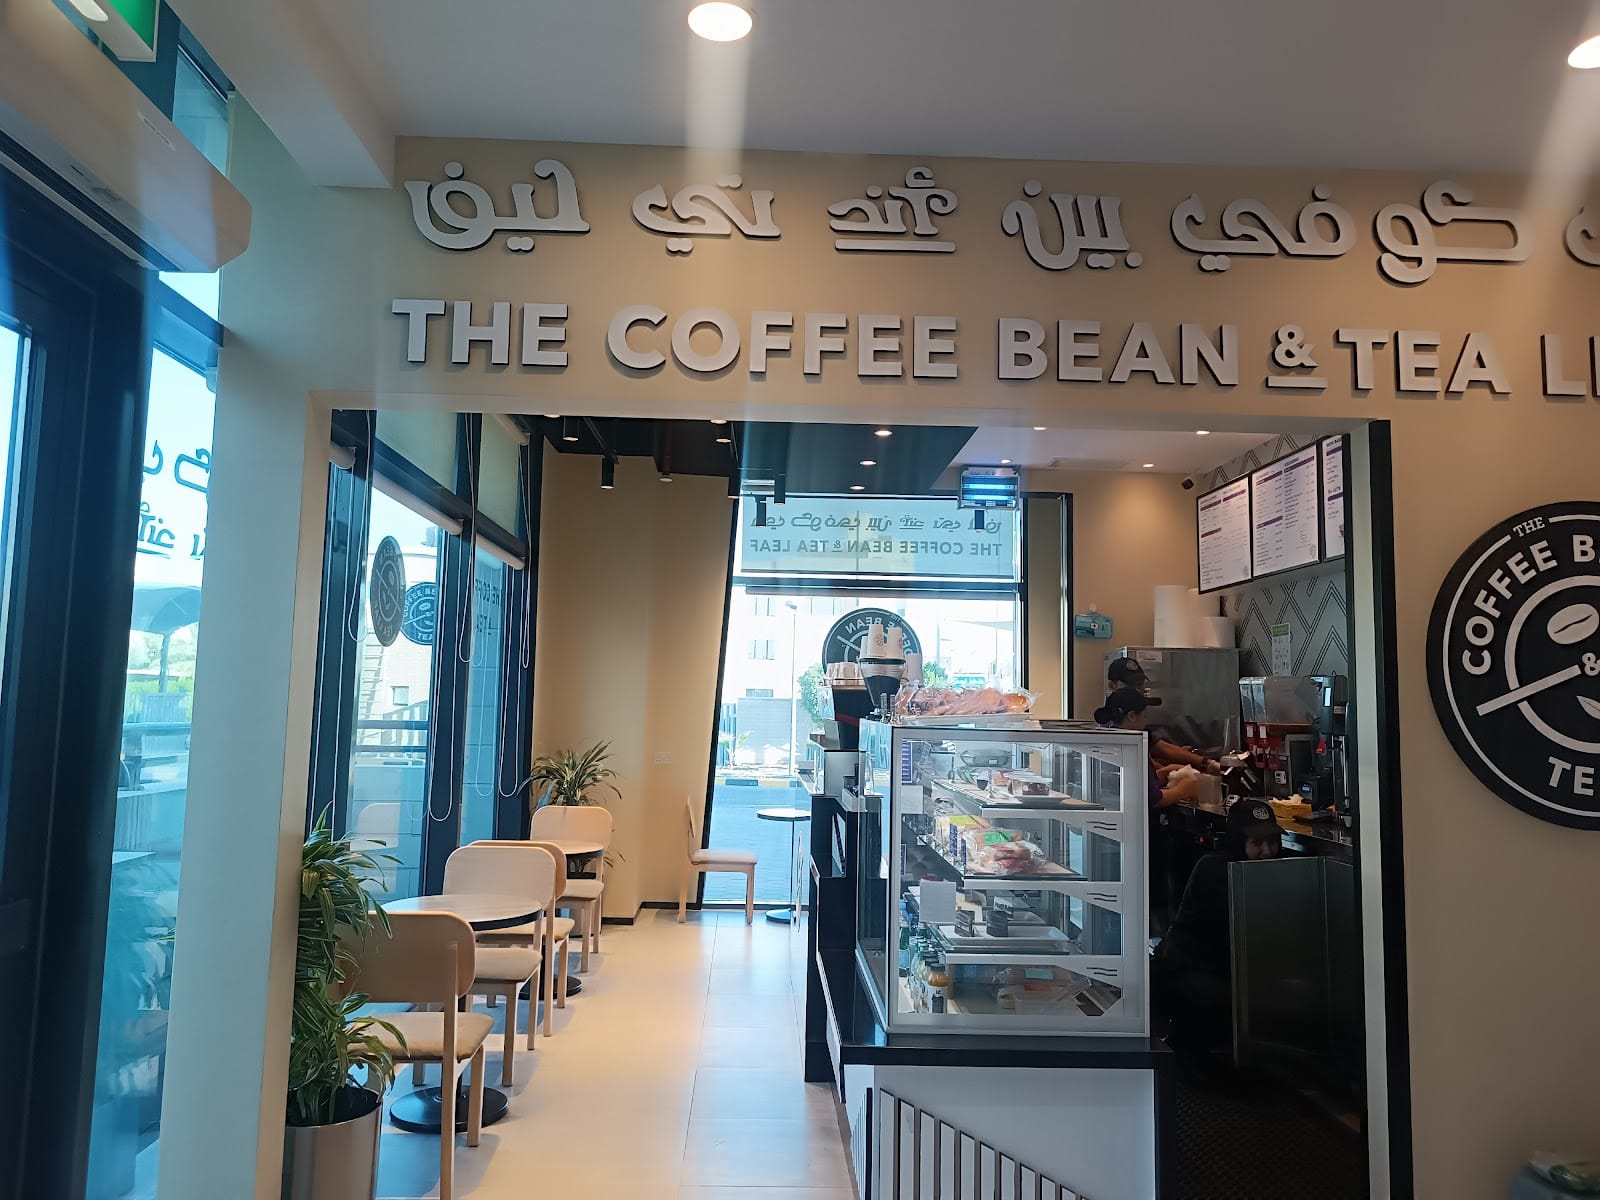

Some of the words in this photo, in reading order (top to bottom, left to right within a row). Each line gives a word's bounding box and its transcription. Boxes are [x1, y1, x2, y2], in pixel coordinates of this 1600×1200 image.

[404, 159, 590, 251] ليف
[631, 173, 782, 255] تي
[827, 166, 958, 252] أند
[1001, 180, 1143, 271] بين
[1170, 180, 1532, 285] كوفي
[392, 298, 568, 367] THE
[607, 304, 959, 379] COFFEE
[997, 317, 1240, 387] BEAN
[1336, 328, 1512, 395] TEA
[1513, 516, 1545, 538] THE
[1462, 540, 1558, 676] COFFEE
[1572, 534, 1600, 563] B
